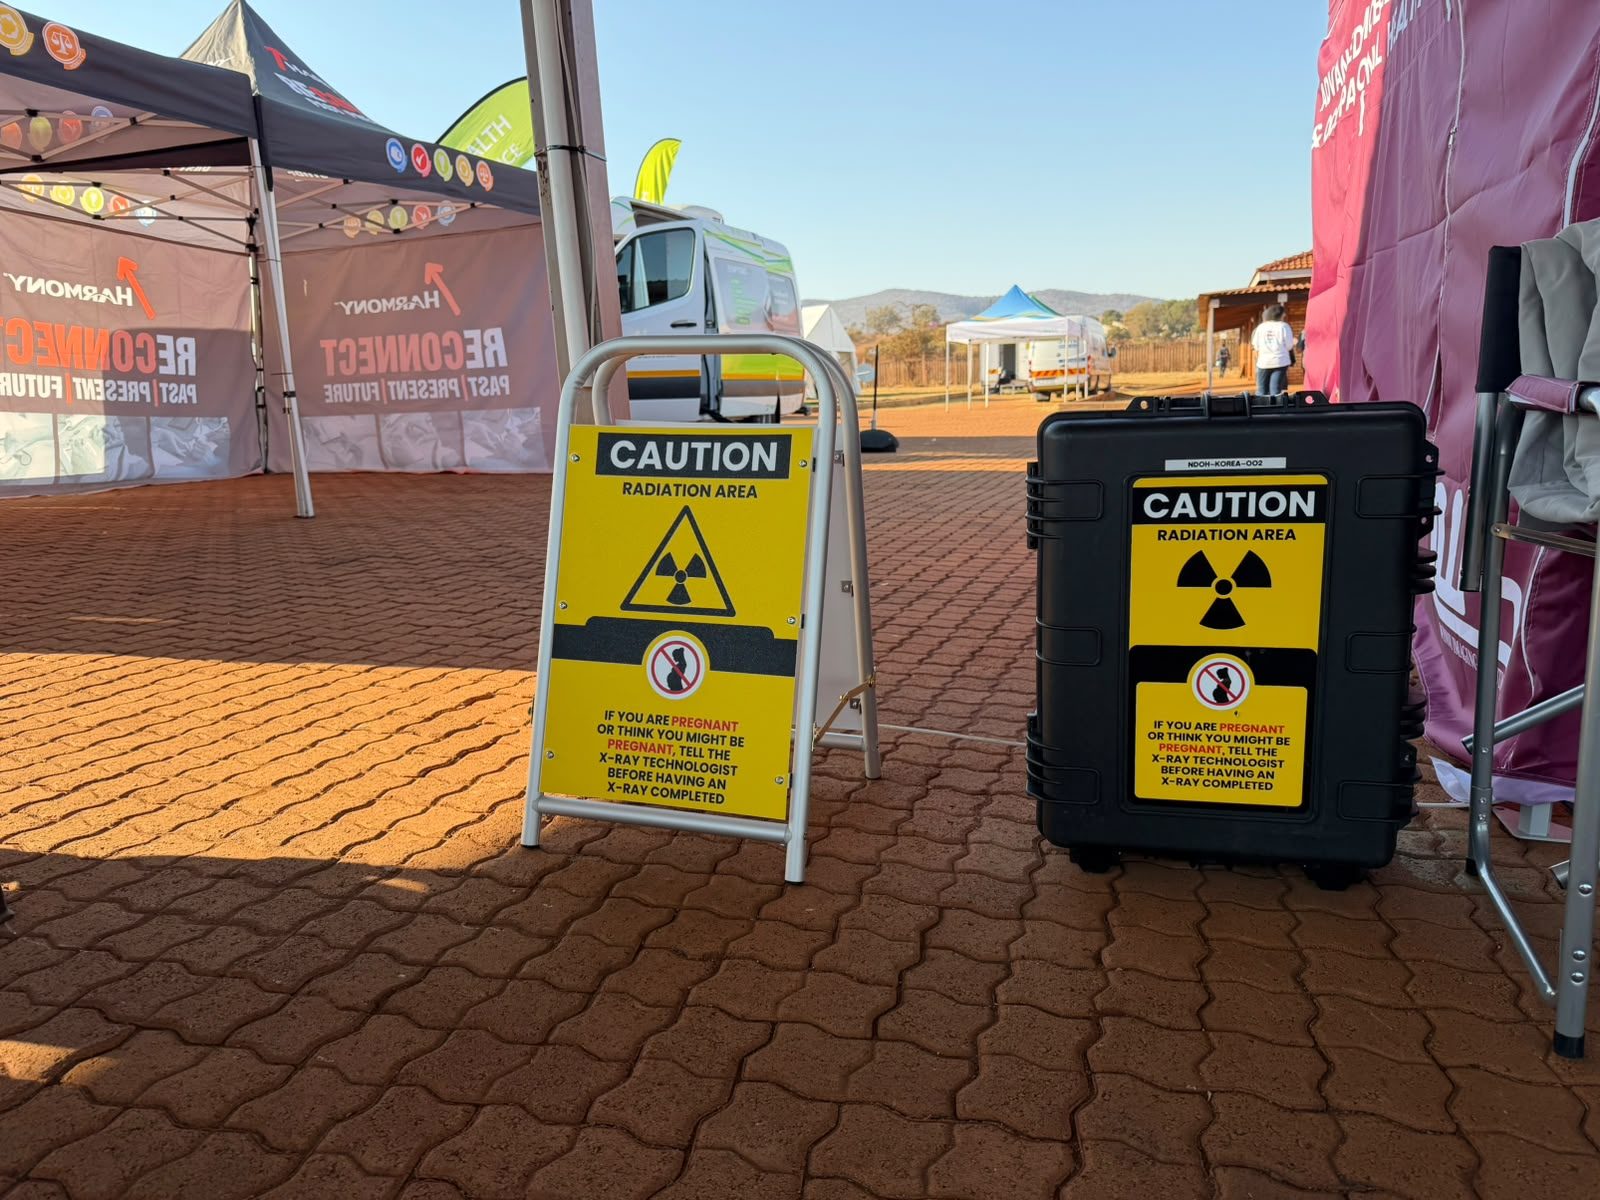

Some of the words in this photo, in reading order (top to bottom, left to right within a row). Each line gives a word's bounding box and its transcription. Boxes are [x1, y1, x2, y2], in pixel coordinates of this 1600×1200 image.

[467, 113, 513, 158] ALTH
[610, 440, 778, 472] CAUTION
[622, 481, 711, 498] RADIATION
[715, 485, 758, 499] AREA
[1143, 490, 1316, 519] CAUTION
[1157, 529, 1248, 541] RADIATION
[1252, 529, 1296, 541] AREA
[604, 710, 615, 720] IF
[617, 711, 644, 723] YOU
[646, 714, 670, 726] ARE
[672, 716, 739, 732] PREGNANT
[1154, 720, 1164, 729] IF
[1166, 721, 1192, 730] YOU
[1194, 722, 1217, 731] ARE
[1220, 723, 1285, 734] PREGNANT
[597, 724, 614, 735] OR
[617, 725, 654, 739] THINK
[657, 729, 683, 742] YOU
[686, 732, 727, 746] MIGHT
[729, 736, 745, 748] BE
[1147, 731, 1165, 741] OR
[1167, 732, 1202, 742] THINK
[1205, 734, 1231, 744] YOU
[1233, 735, 1273, 745] MIGHT
[1275, 737, 1291, 746] BE
[607, 739, 676, 757] PREGNANT,
[679, 745, 705, 758] TELL
[707, 748, 731, 761] THE
[1152, 754, 1191, 764] X-RAY
[1193, 755, 1285, 768] TECHNOLOGIST
[1159, 743, 1225, 756] PREGNANT,
[1228, 746, 1252, 756] TELL
[1255, 747, 1277, 757] THE
[599, 752, 640, 766] X-RAY
[642, 756, 738, 776] TECHNOLOGIST
[1161, 766, 1204, 776] BEFORE
[1207, 769, 1255, 779] HAVING
[1257, 770, 1275, 780] AN
[607, 767, 653, 782] BEFORE
[655, 773, 705, 787] HAVING
[707, 778, 726, 790] AN
[1162, 777, 1200, 787] X-RAY
[1202, 778, 1274, 791] COMPLETED
[607, 781, 648, 795] X-RAY
[650, 786, 725, 804] COMPLETED
